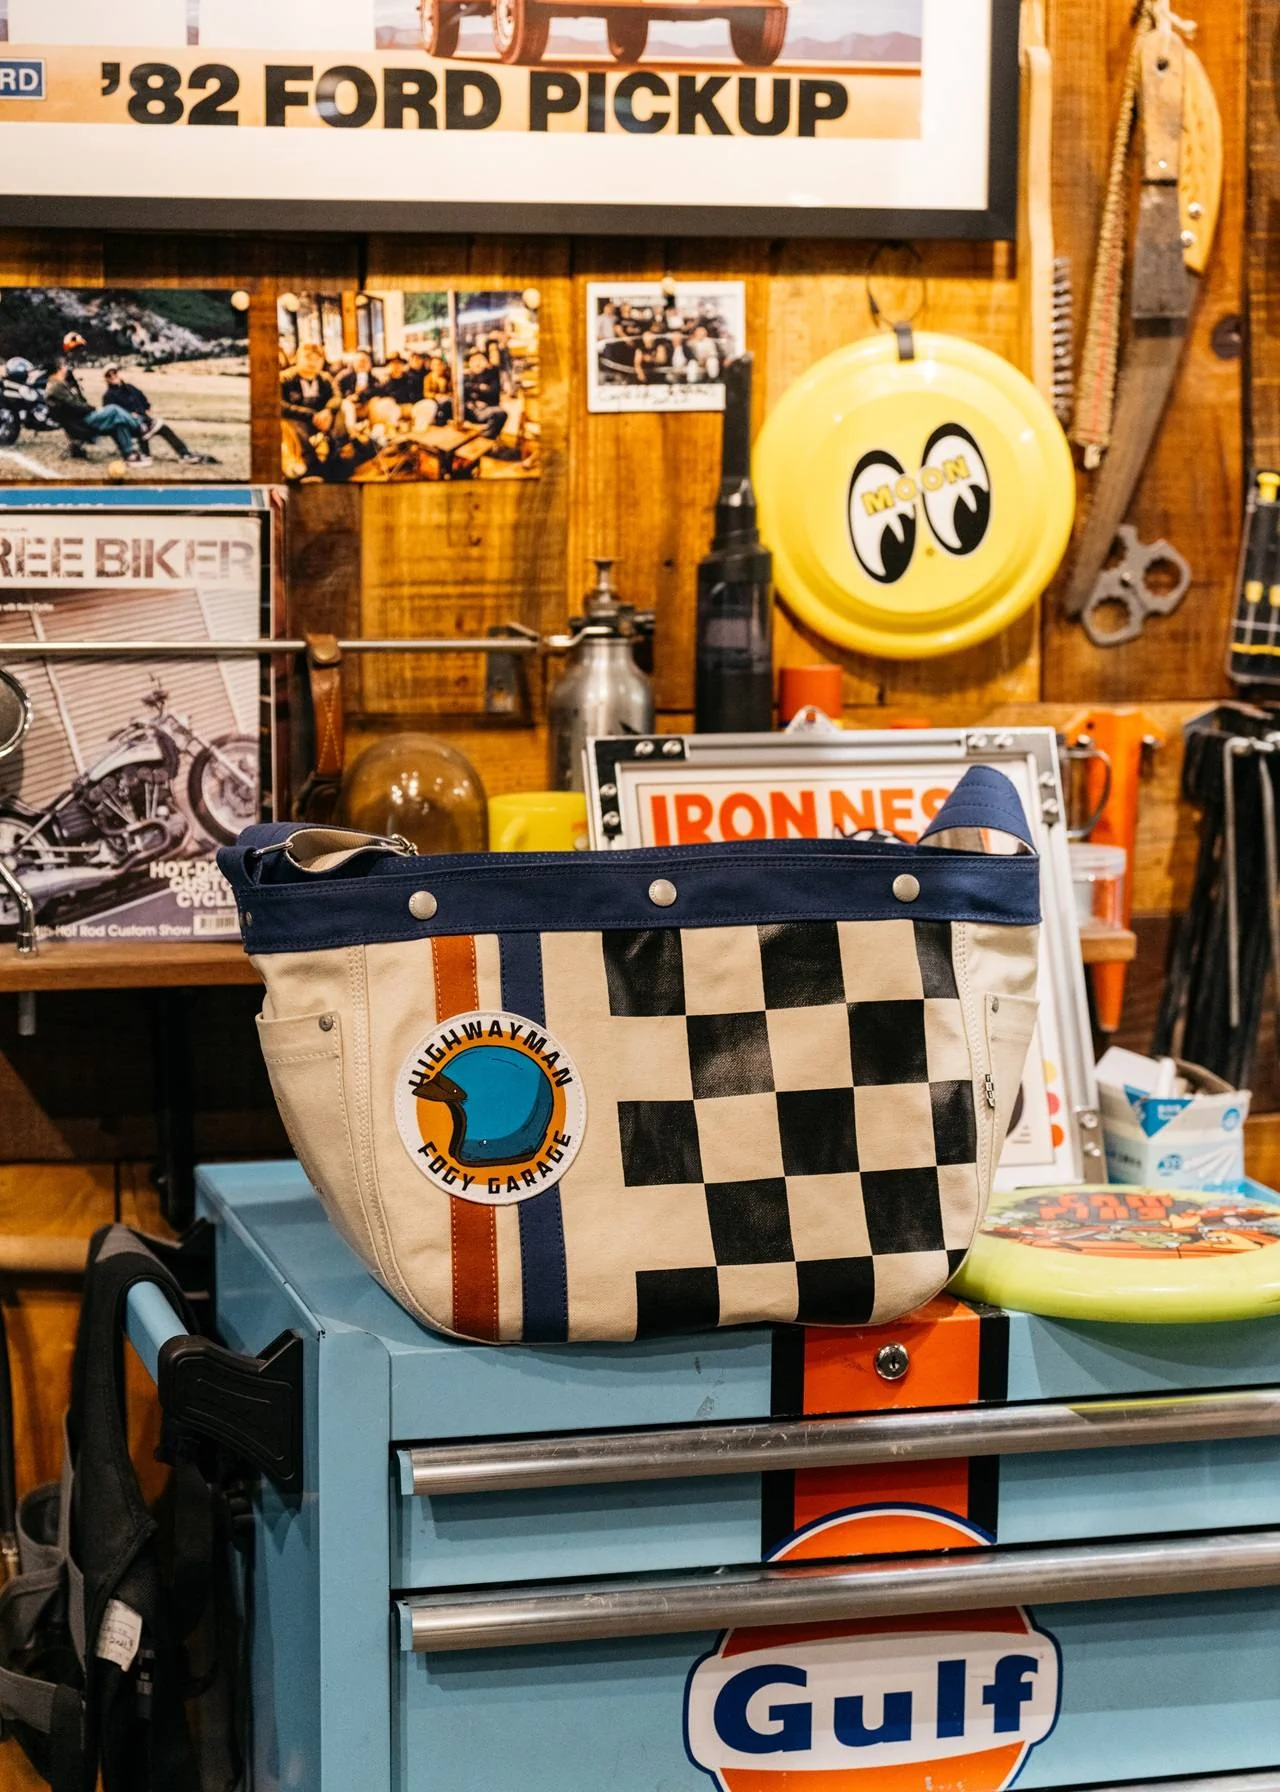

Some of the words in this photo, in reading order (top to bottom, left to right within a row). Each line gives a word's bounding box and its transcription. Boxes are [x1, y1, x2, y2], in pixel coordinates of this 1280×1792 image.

[101, 62, 240, 126] '82
[264, 65, 502, 130] FORD
[528, 70, 848, 137] PICKUP
[861, 455, 970, 516] MOON
[95, 538, 255, 580] BIKER
[651, 791, 818, 846] IRON
[107, 923, 157, 937] Custom
[159, 923, 191, 937] Show
[408, 1020, 573, 1090] HIGHWAYMAN
[417, 1141, 476, 1192] FOGY
[487, 1130, 572, 1195] GARAGE
[713, 1654, 1039, 1755] Gulf
